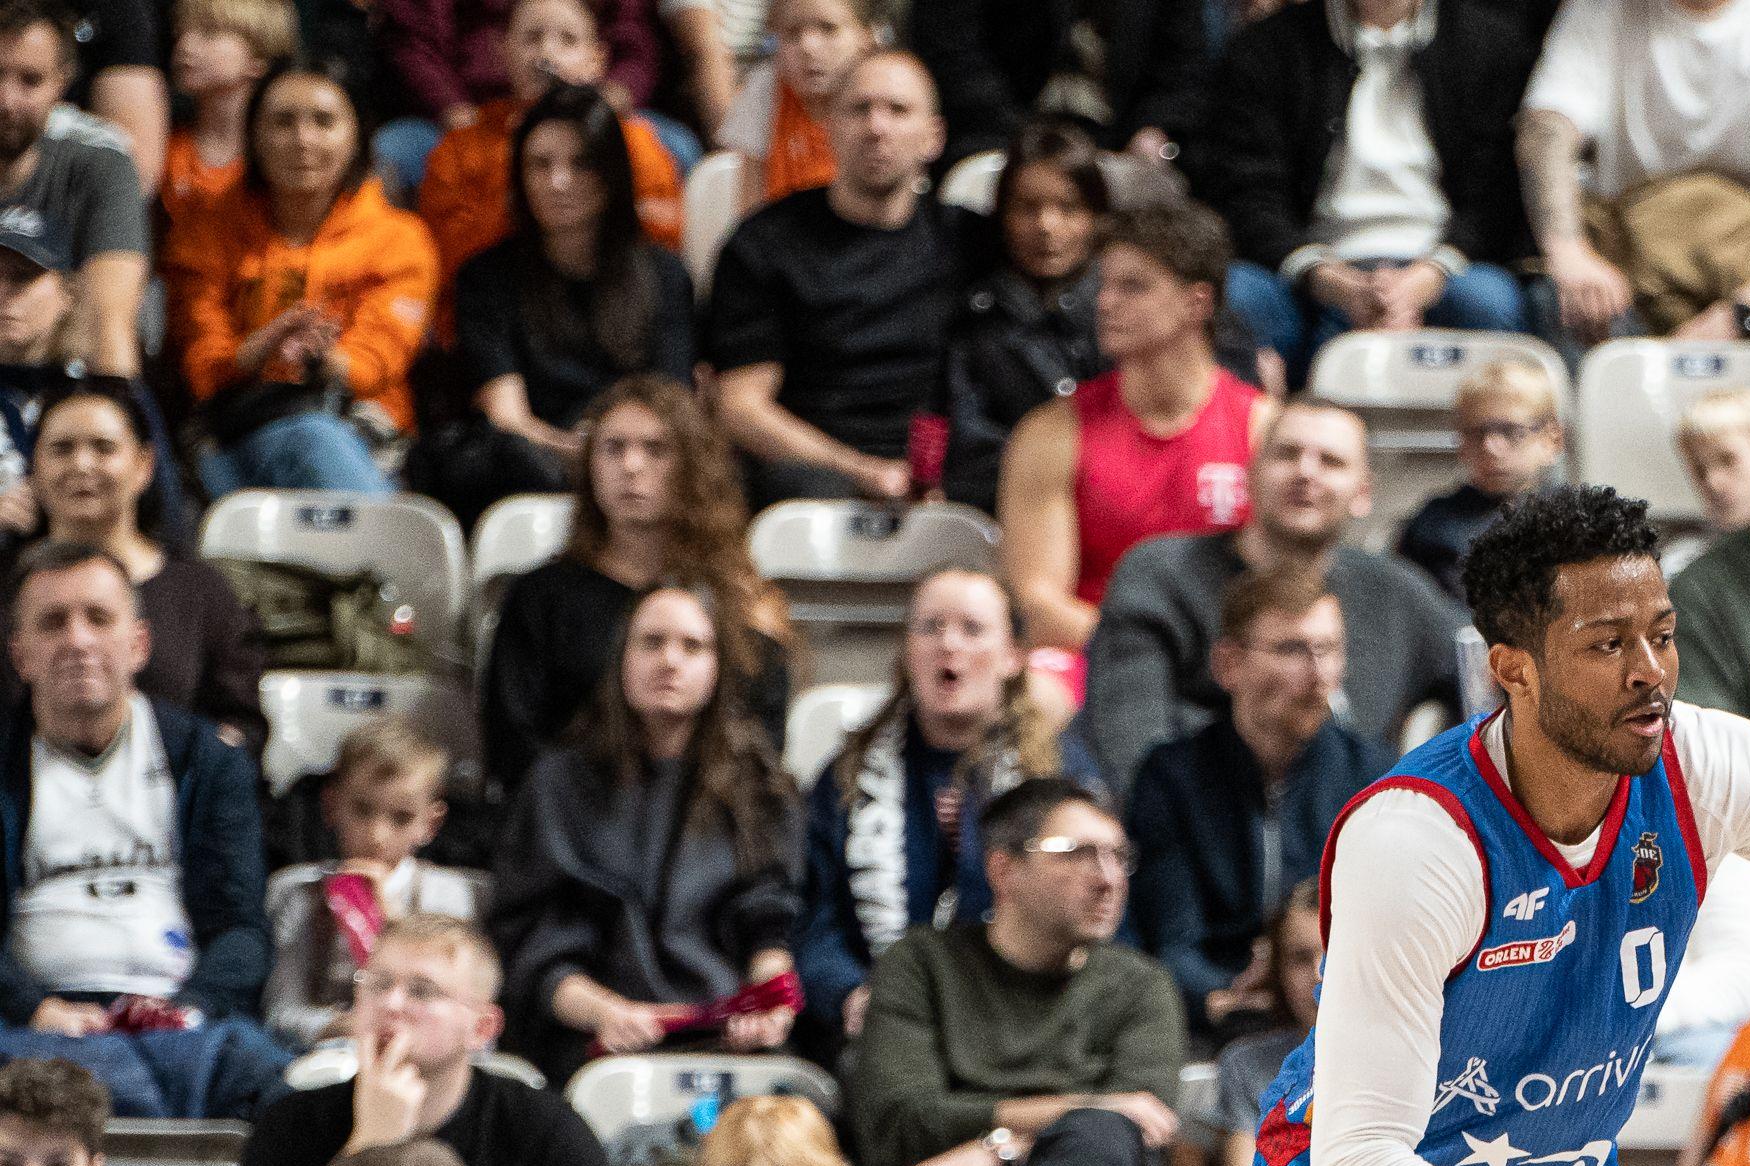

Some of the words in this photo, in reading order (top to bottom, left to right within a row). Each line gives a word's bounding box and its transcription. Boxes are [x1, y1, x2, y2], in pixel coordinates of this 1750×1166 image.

[1503, 887, 1549, 921] 4F
[1484, 945, 1532, 966] ORLEN
[1620, 926, 1667, 1010] 0
[1515, 1034, 1653, 1111] arriv
